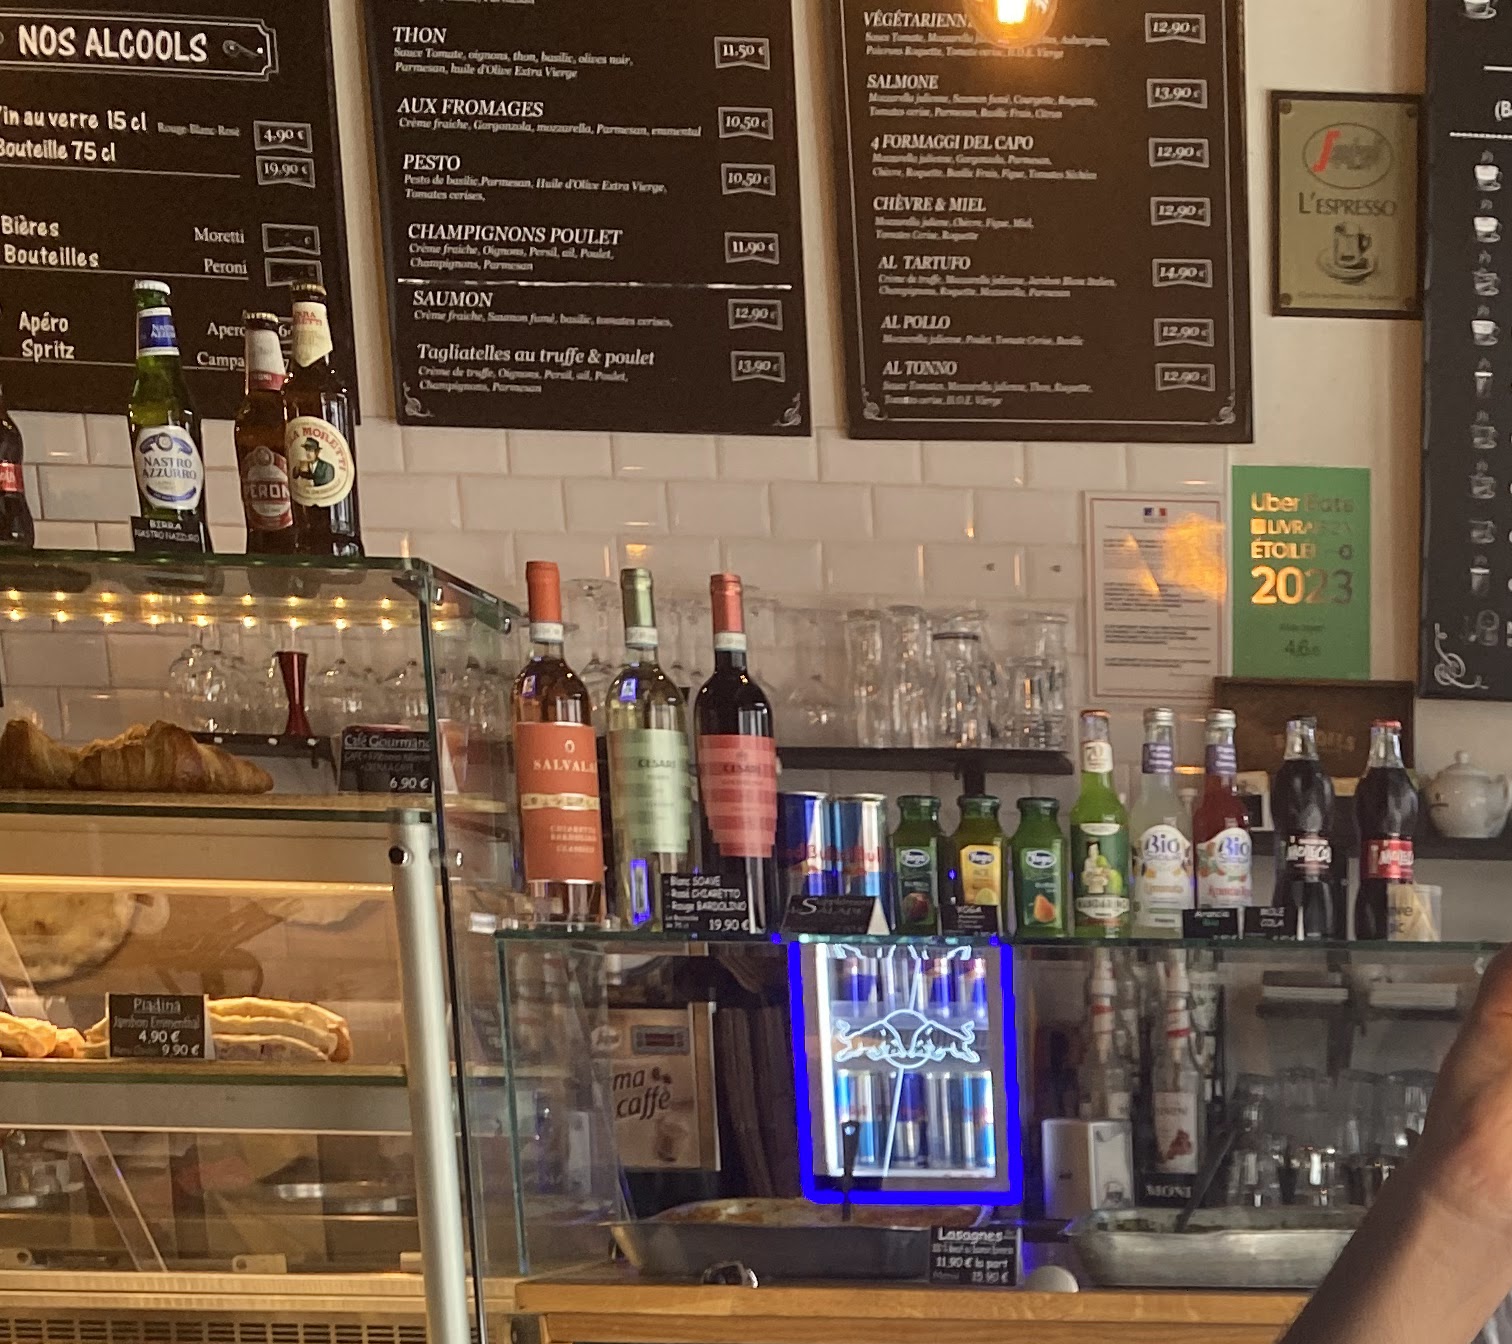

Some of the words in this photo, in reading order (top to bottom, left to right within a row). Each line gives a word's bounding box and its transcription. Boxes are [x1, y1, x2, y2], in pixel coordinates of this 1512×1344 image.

[18, 24, 76, 56] NOS
[85, 27, 208, 62] ALCOOLS
[393, 26, 447, 44] THON
[867, 74, 939, 89] SALMONE
[397, 97, 438, 114] AUX
[442, 99, 544, 117] FROMAGES
[23, 110, 45, 127] au
[48, 111, 99, 130] verre
[106, 109, 127, 131] 15
[130, 111, 148, 131] cl
[71, 141, 97, 162] 75
[101, 142, 117, 162] cl
[883, 134, 960, 150] FORMAGGI
[963, 135, 993, 150] DEL
[994, 136, 1034, 150] CAPO
[403, 154, 461, 172] PESTO
[873, 193, 932, 212] CHÈVRE
[949, 198, 986, 212] MIEL
[1298, 191, 1398, 216] L'ESPRESSO
[1, 214, 60, 238] Bières
[194, 226, 245, 244] Moretti
[408, 223, 546, 243] CHAMPIGNONS
[550, 227, 623, 246] POULET
[4, 243, 99, 268] Bouteilles
[878, 256, 898, 270] AL
[903, 256, 971, 270] TARTUFO
[204, 258, 248, 275] Peroni
[413, 290, 493, 307] SAUMON
[19, 310, 69, 337] Apéro
[881, 316, 900, 330] AL
[903, 316, 951, 330] POLLO
[22, 338, 75, 363] Spritz
[417, 343, 510, 364] Tagliatelles
[514, 349, 535, 362] au
[540, 347, 584, 368] truffe
[587, 349, 601, 365] &
[604, 348, 655, 368] poulet
[882, 361, 902, 375] AL
[143, 456, 193, 469] NASTRO
[142, 468, 198, 481] AZZURRO
[1251, 492, 1300, 513] Uber
[1250, 565, 1354, 605] 2023
[139, 1030, 168, 1044] 4,90
[613, 1069, 645, 1092] ma
[616, 1085, 671, 1121] caffè
